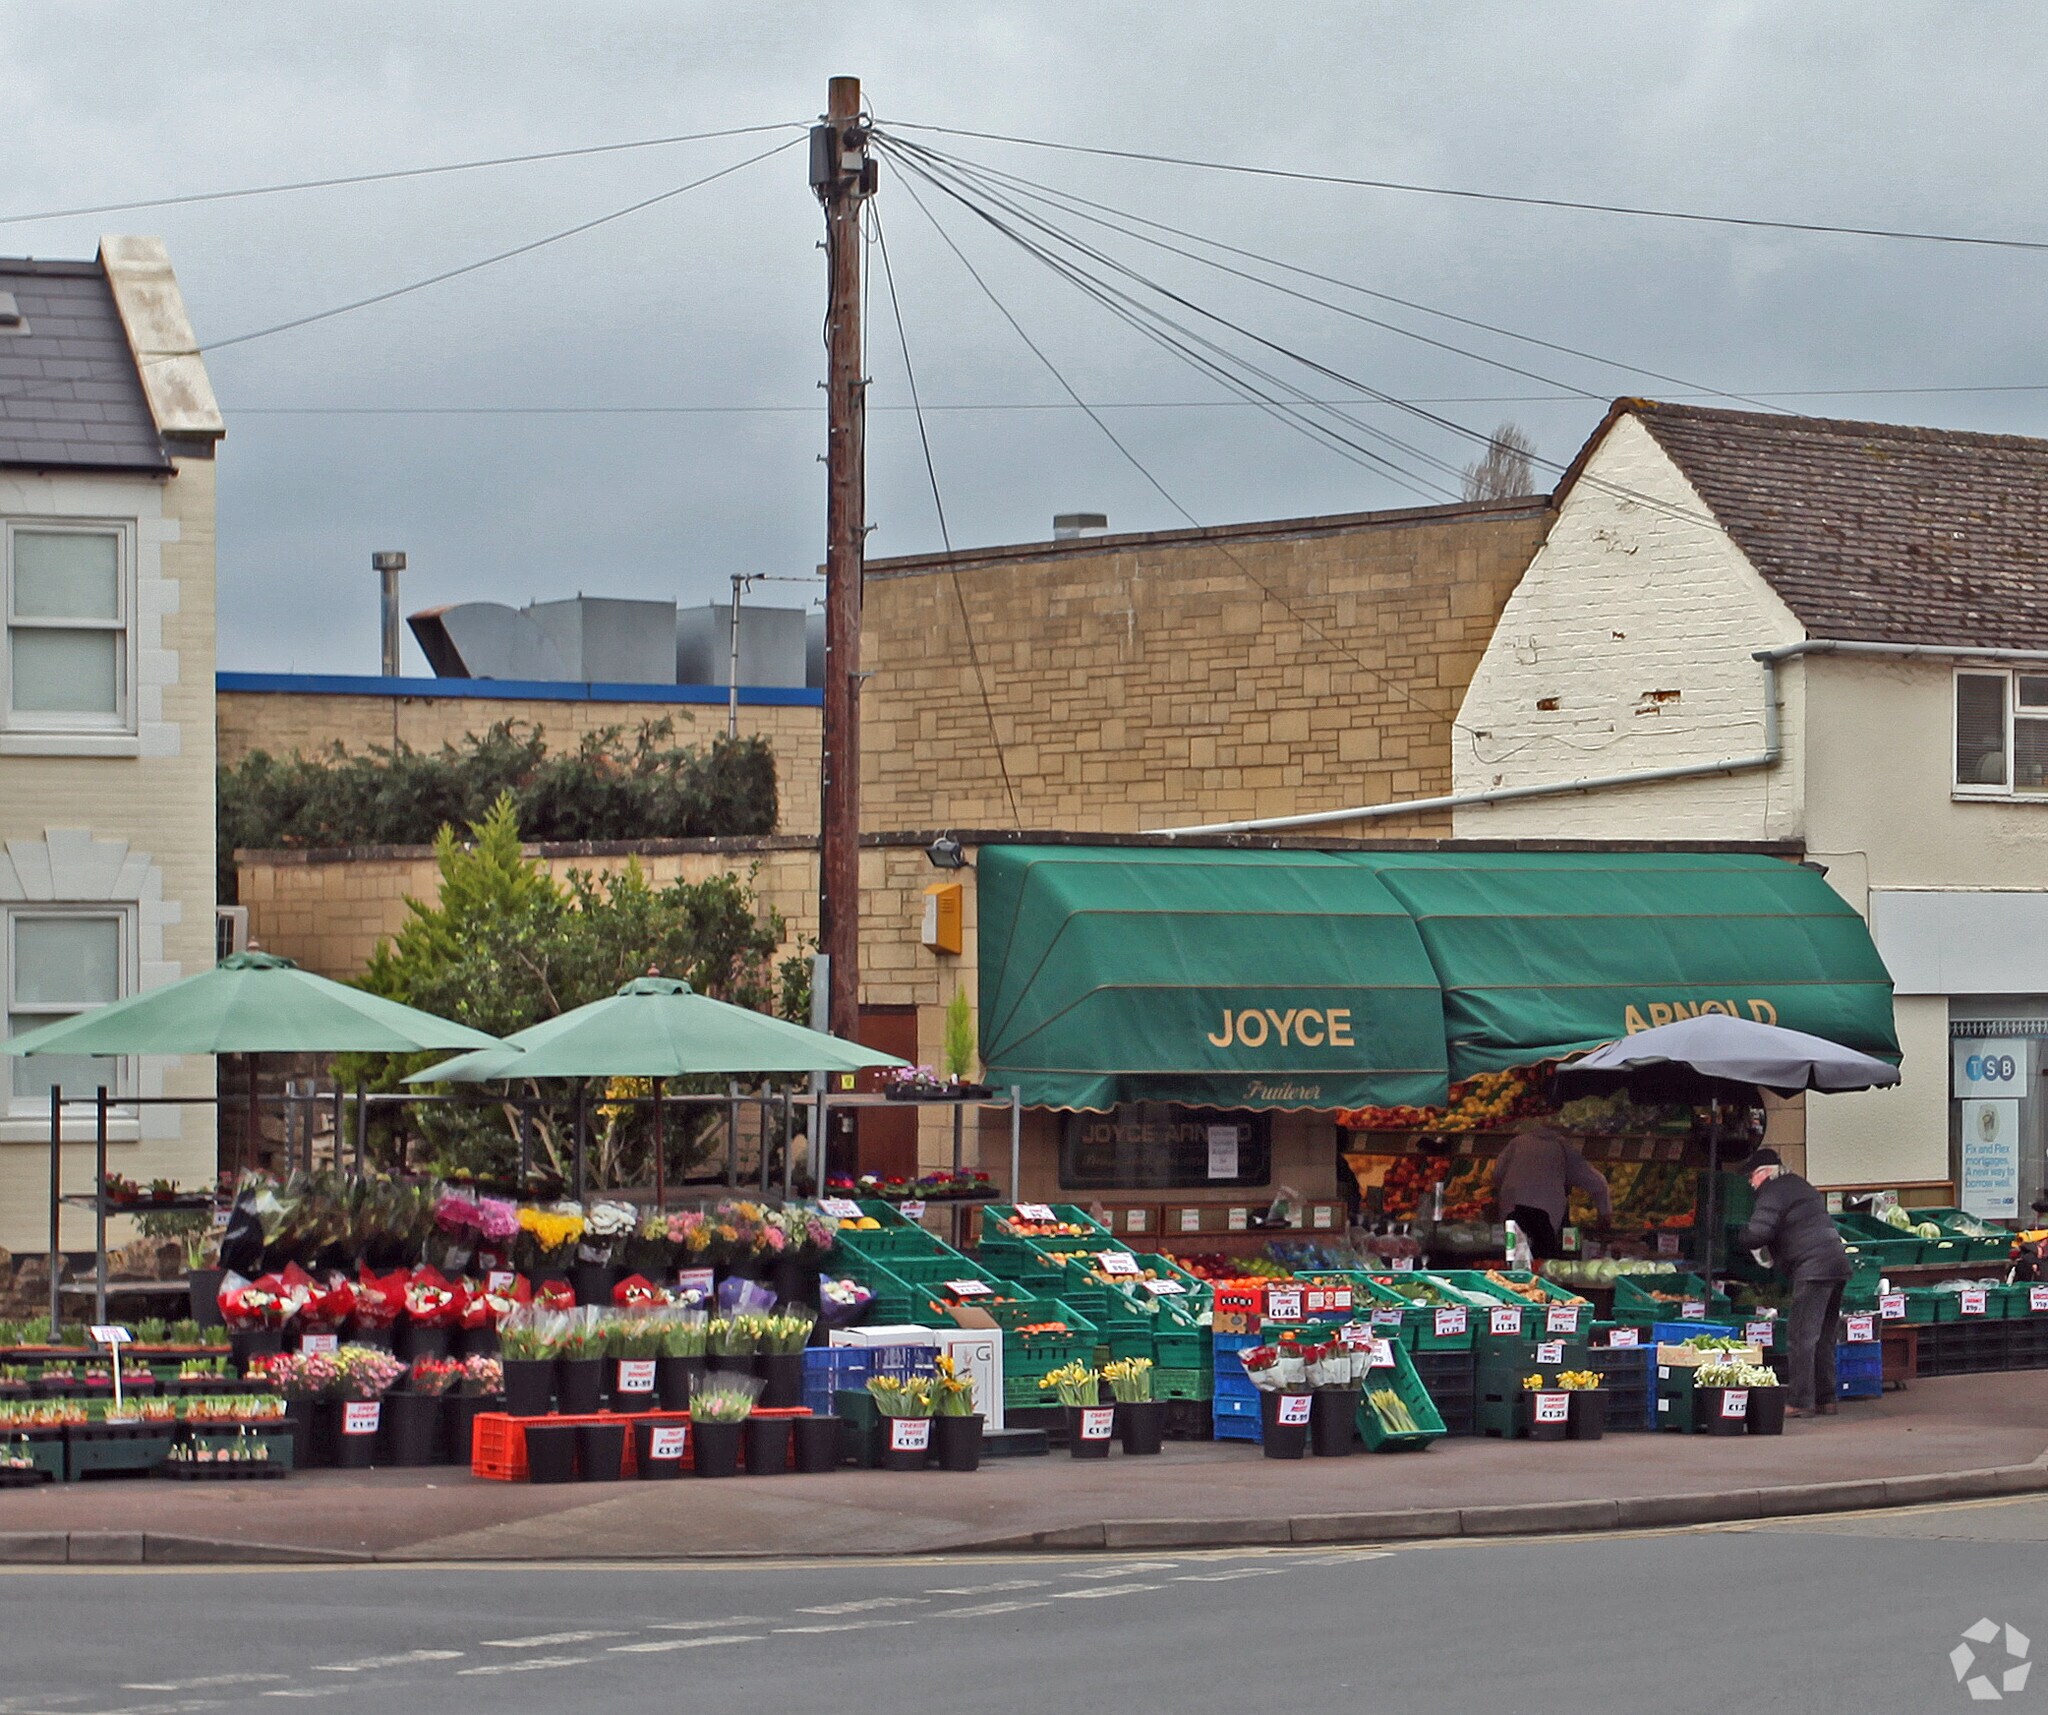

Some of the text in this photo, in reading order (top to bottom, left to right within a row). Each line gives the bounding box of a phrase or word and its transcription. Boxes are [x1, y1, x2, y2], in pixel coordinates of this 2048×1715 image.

[1207, 1008, 1355, 1047] JOYCE
[1970, 1060, 2012, 1076] TSB
[1082, 1123, 1251, 1142] JOYCE ARND
[1966, 1145, 1977, 1153] Fix
[1978, 1144, 1993, 1153] and
[1990, 1169, 2006, 1178] way
[2006, 1167, 2015, 1176] to
